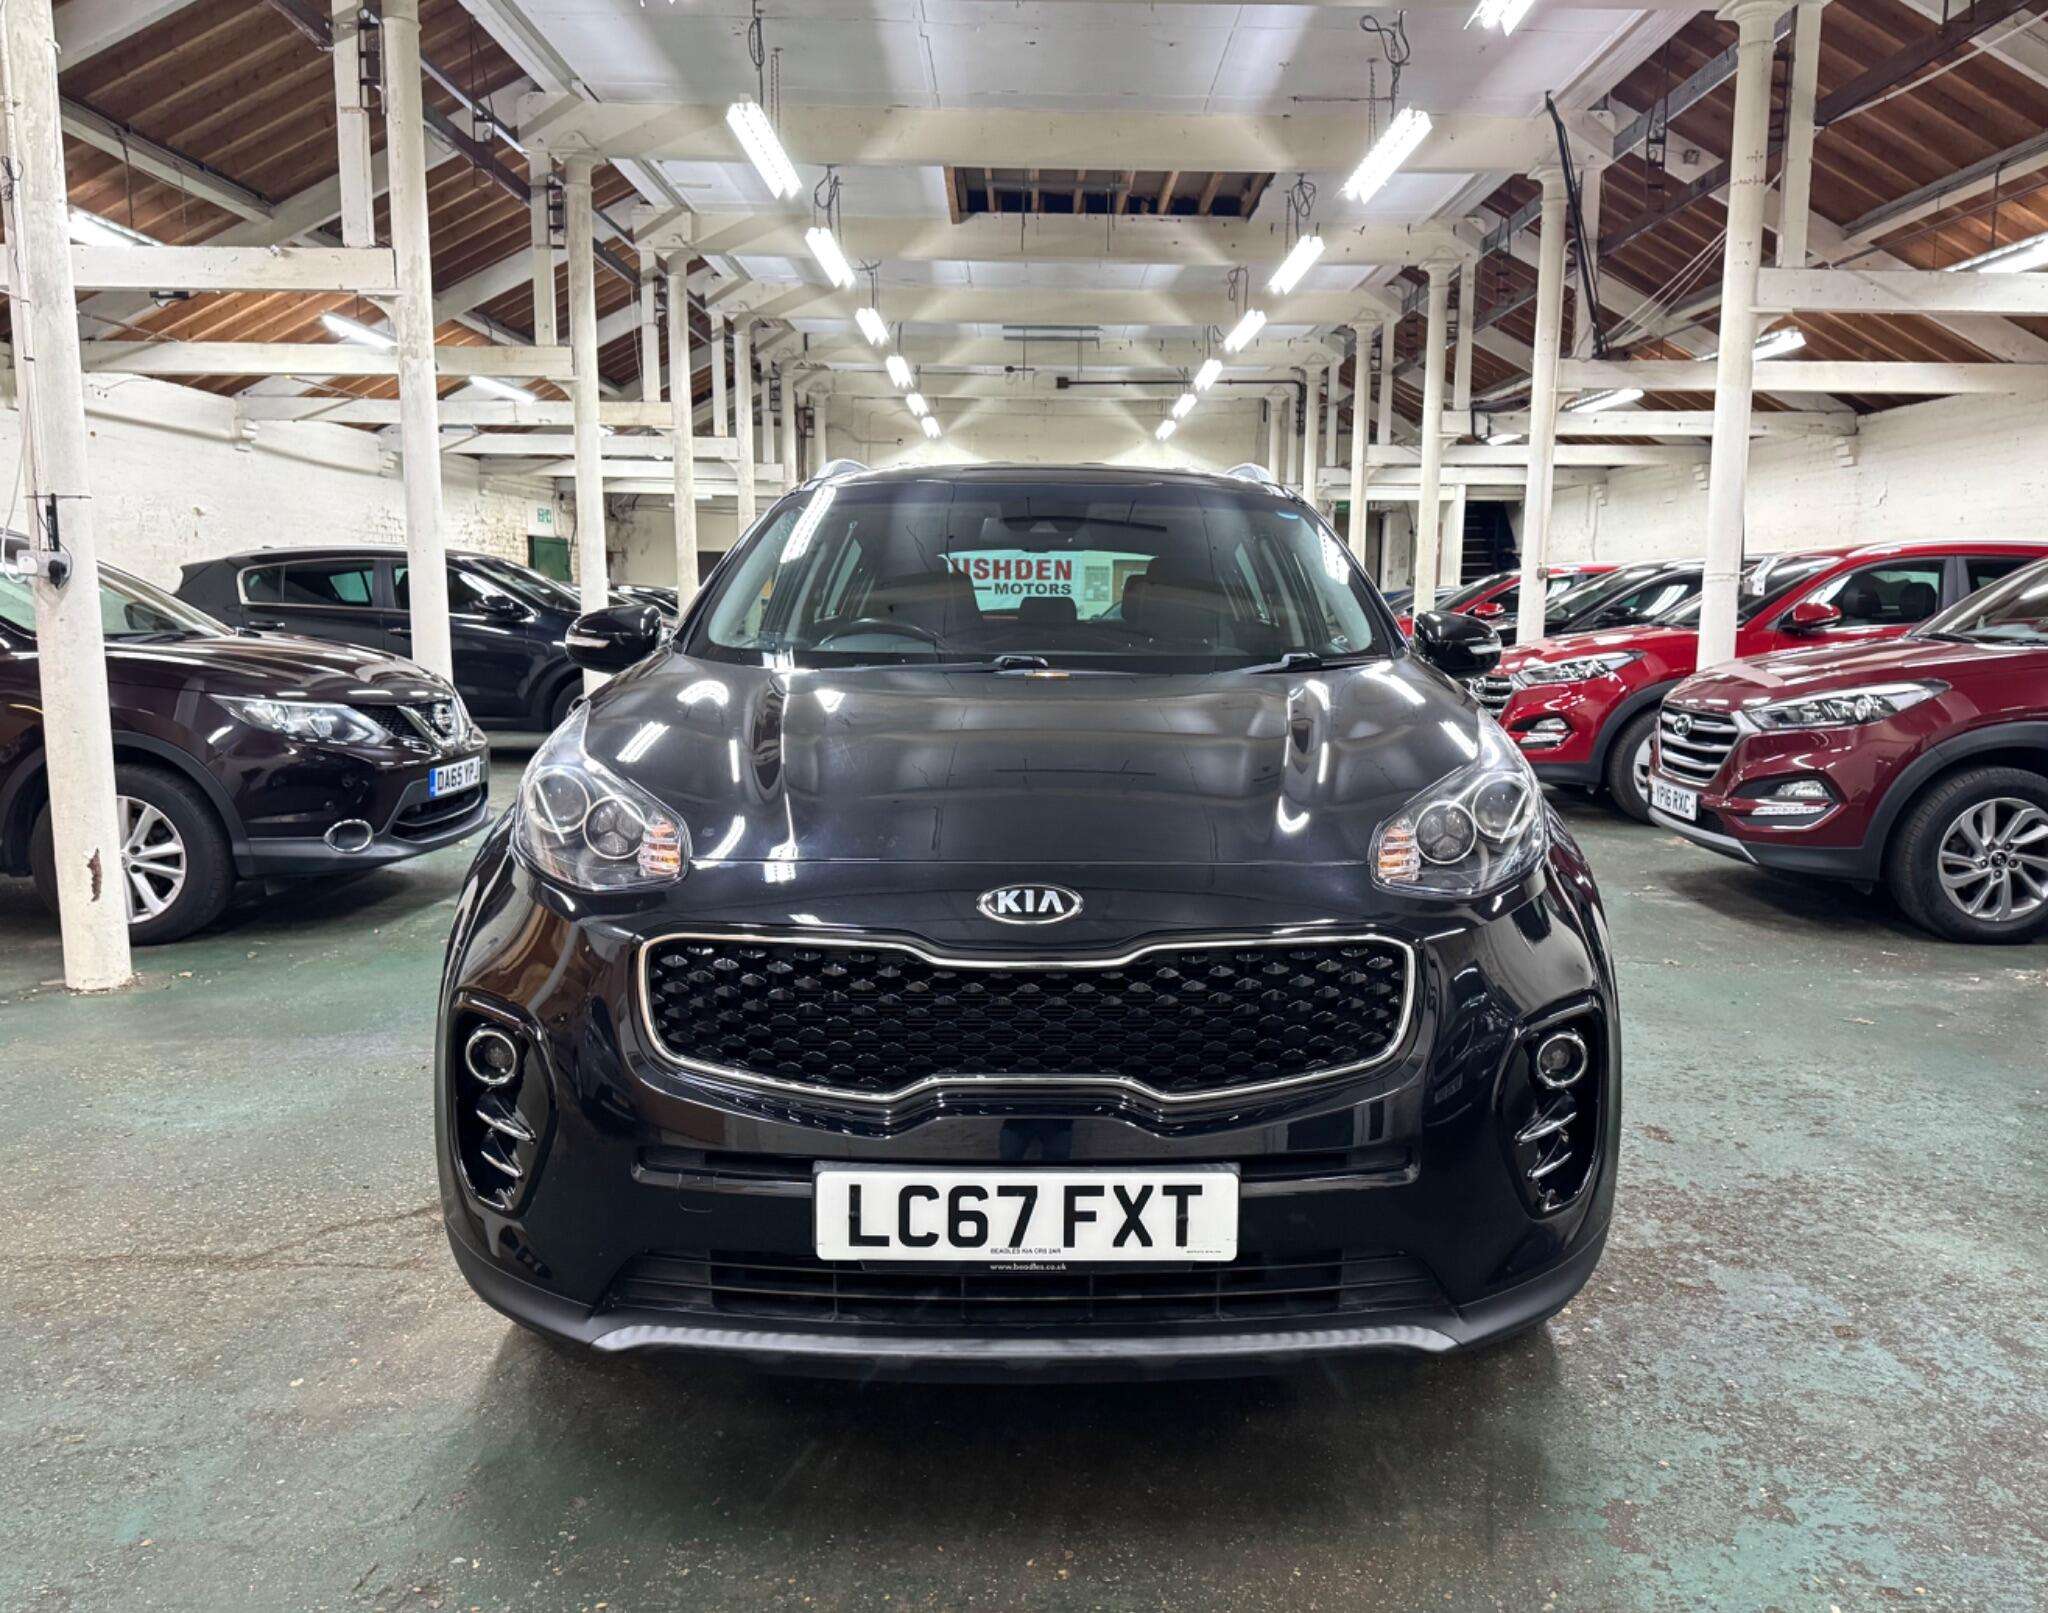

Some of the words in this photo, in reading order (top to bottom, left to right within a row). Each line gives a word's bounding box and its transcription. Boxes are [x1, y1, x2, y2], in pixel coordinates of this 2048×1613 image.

[994, 583, 1072, 595] MOTORS
[997, 889, 1064, 913] KIA
[848, 1184, 1038, 1248] LC67
[1063, 1184, 1203, 1248] FXT
